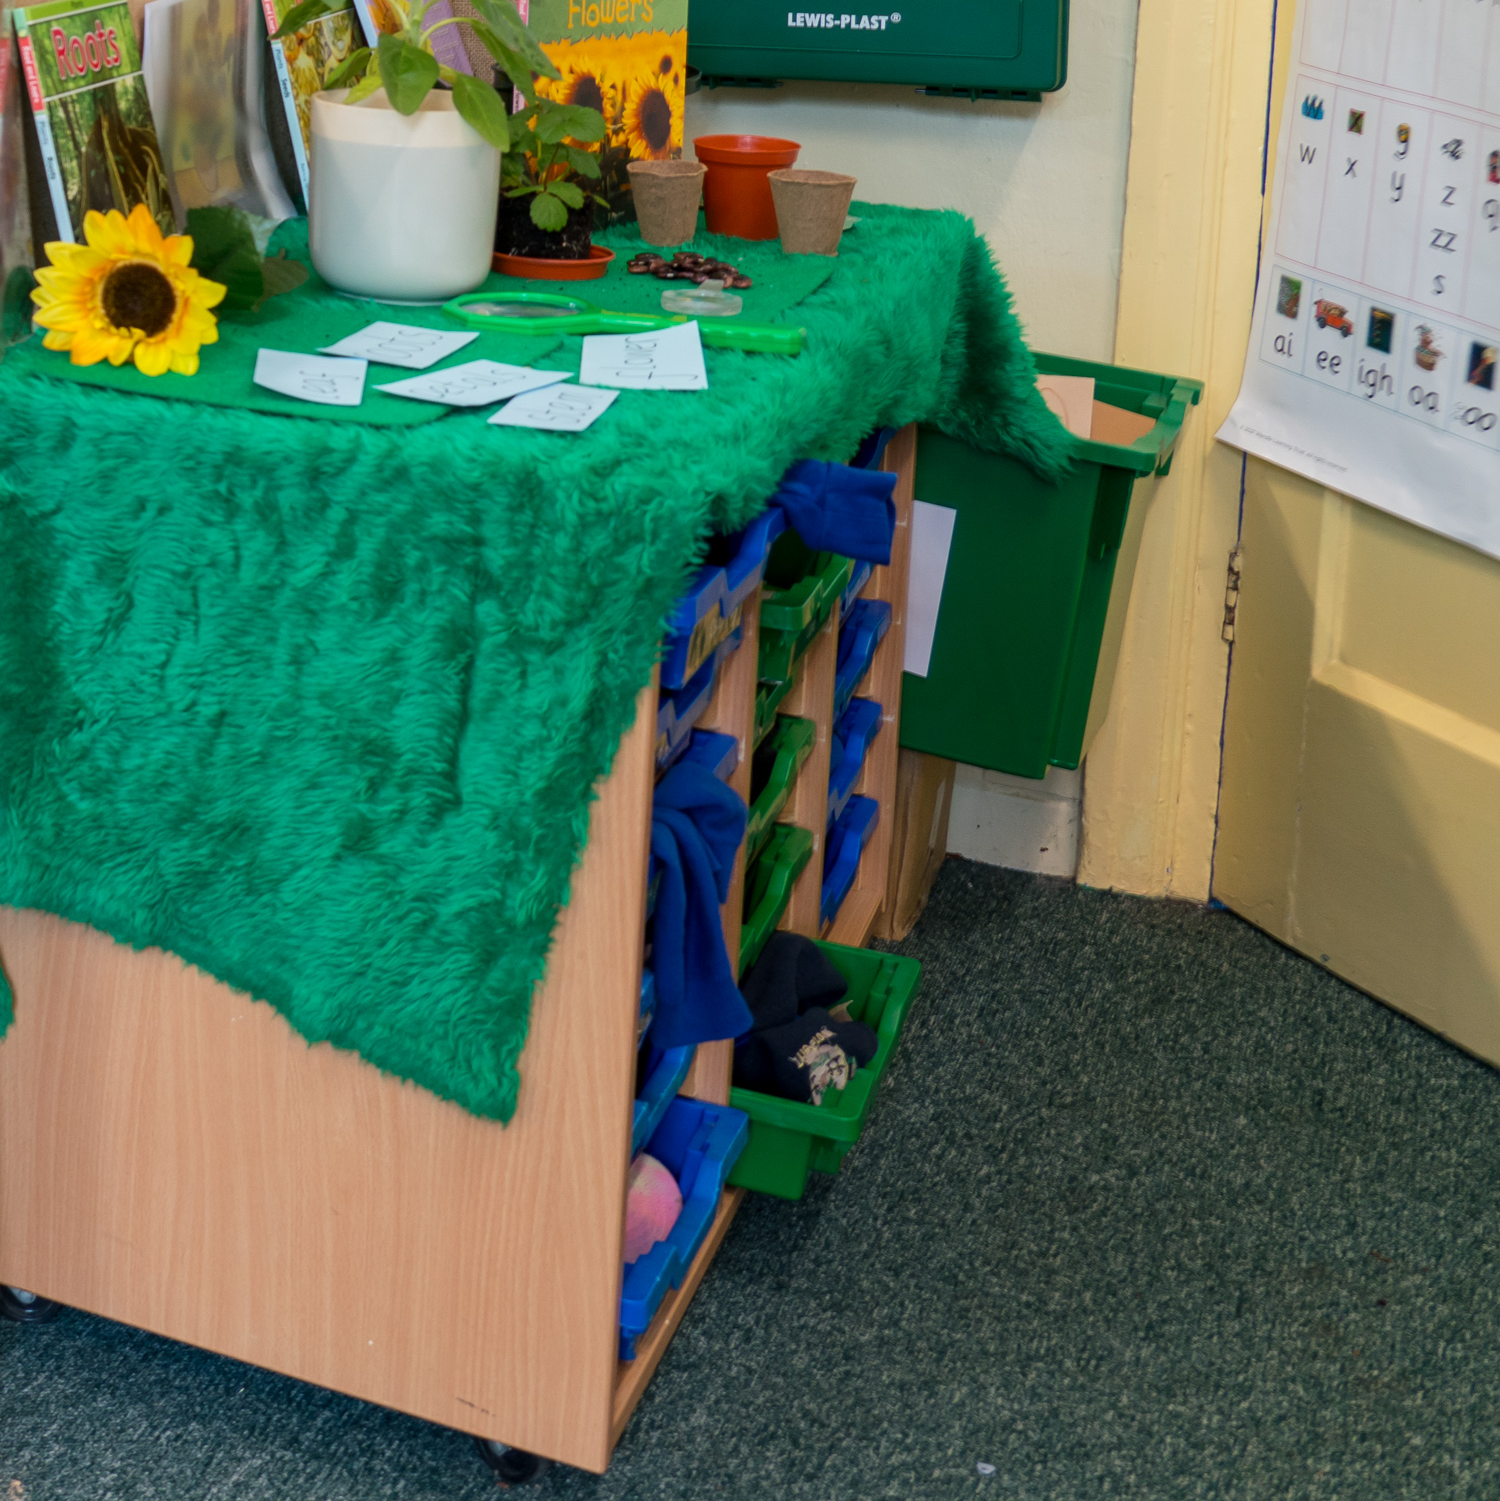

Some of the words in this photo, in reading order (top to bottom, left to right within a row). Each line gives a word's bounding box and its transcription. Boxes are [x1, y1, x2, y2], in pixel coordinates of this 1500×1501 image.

[50, 20, 121, 80] Roots
[1274, 329, 1294, 359] ai
[1316, 348, 1342, 376] ee
[1357, 357, 1394, 399] igh
[1408, 385, 1439, 415] oa
